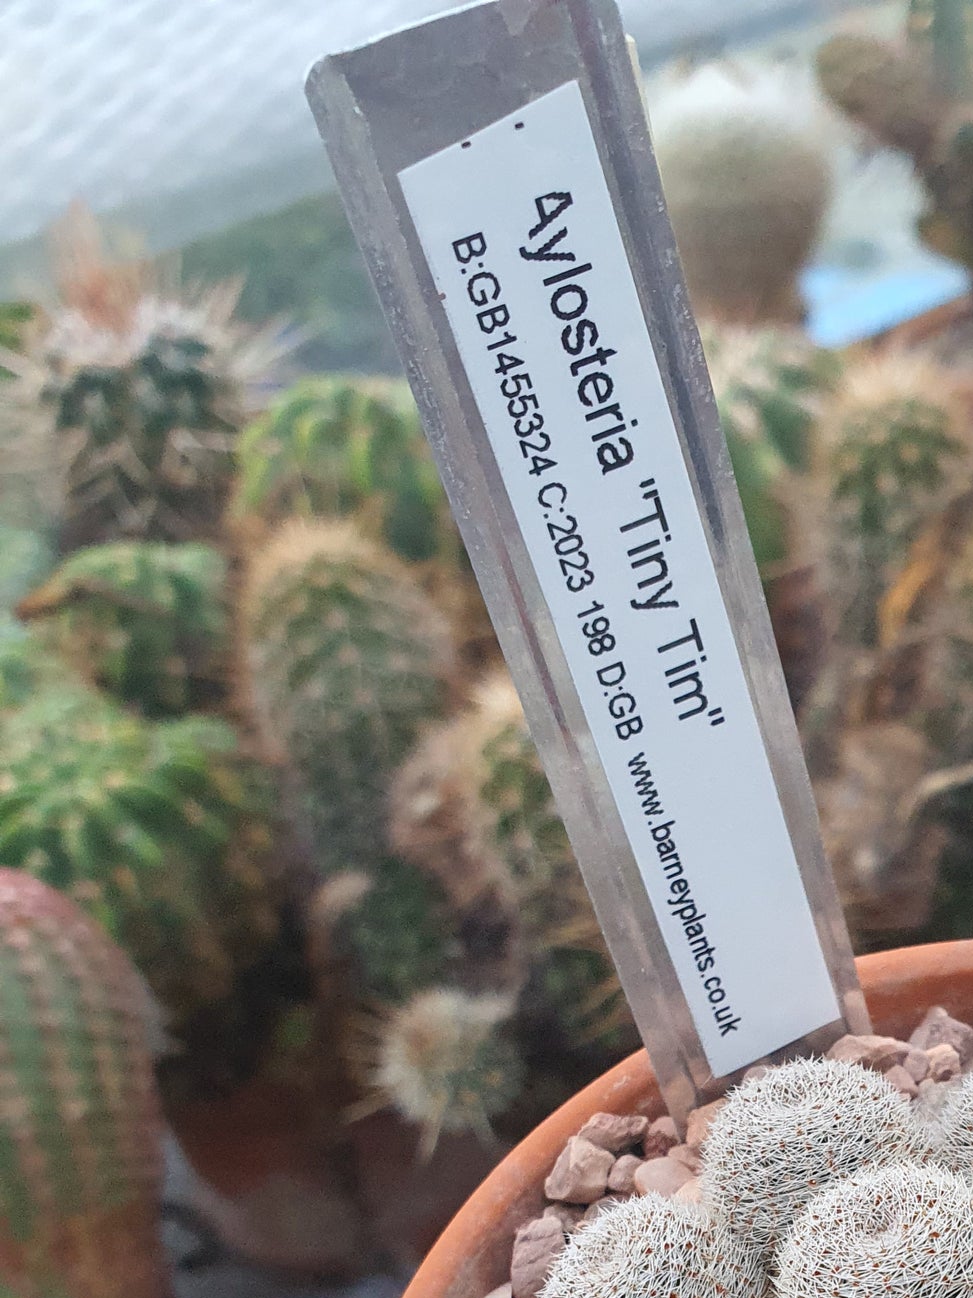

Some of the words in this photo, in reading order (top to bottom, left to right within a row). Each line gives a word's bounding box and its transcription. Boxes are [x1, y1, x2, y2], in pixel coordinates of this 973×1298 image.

[450, 230, 559, 478] B:GB1455324
[518, 190, 637, 477] Aylosteria
[618, 476, 681, 612] "Tiny
[656, 616, 727, 728] Tim"
[536, 481, 596, 594] C:2023
[575, 599, 618, 658] 198
[595, 660, 645, 742] D:GB
[626, 750, 743, 1038] www.barneyplants.co.uk
